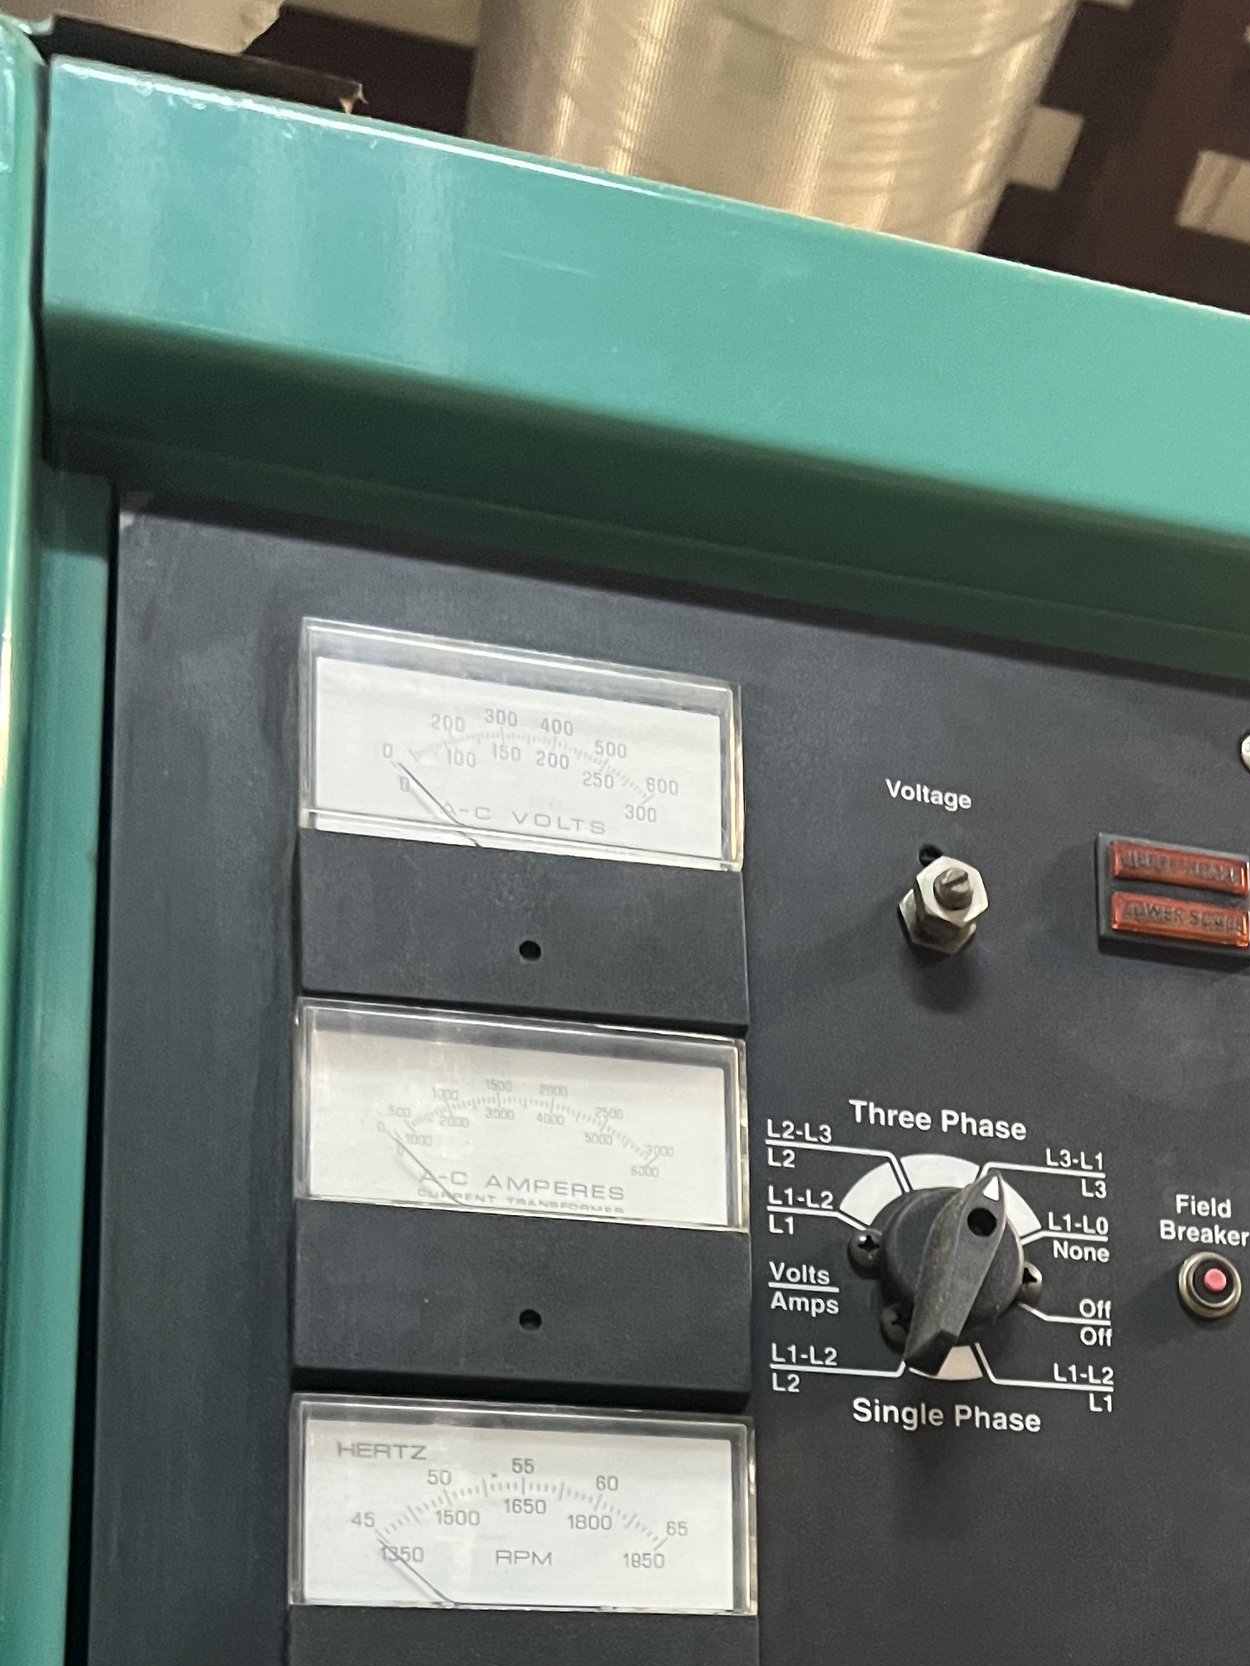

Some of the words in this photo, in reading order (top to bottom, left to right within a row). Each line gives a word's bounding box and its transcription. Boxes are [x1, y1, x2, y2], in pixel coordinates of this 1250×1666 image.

[382, 742, 394, 759] 0
[430, 713, 465, 734] 200
[484, 708, 518, 728] 300
[540, 716, 574, 737] 400
[594, 739, 627, 759] 500
[646, 778, 679, 797] 600
[446, 750, 476, 769] 100
[492, 744, 522, 763] 150
[535, 750, 570, 771] 200
[583, 771, 615, 791] 250
[624, 804, 657, 824] 300
[885, 778, 972, 812] Voltage
[512, 810, 606, 836] VOLTS
[432, 1088, 460, 1102] 1000
[486, 1079, 514, 1092] 1500
[767, 1119, 832, 1143] L2-L3
[849, 1099, 932, 1130] Three
[941, 1110, 1027, 1140] Phase
[767, 1148, 796, 1169] L2
[1046, 1148, 1104, 1170] L3-L1
[419, 1170, 468, 1186] A-C
[485, 1175, 624, 1202] AMPERES
[768, 1185, 834, 1209] L1-L2
[1081, 1178, 1107, 1199] L3
[1176, 1193, 1232, 1218] Field
[768, 1214, 795, 1235] L1
[1160, 1219, 1250, 1247] Breaker
[1053, 1241, 1110, 1263] None
[769, 1261, 831, 1286] Volts
[770, 1291, 840, 1317] Amps
[1079, 1298, 1112, 1320] Off
[1080, 1326, 1112, 1347] Off
[771, 1342, 837, 1366] L1-L2
[772, 1373, 800, 1392] L2
[1053, 1363, 1114, 1385] L1-L2
[852, 1397, 944, 1432] Single
[955, 1404, 1041, 1432] Phase
[1089, 1393, 1114, 1413] L1
[337, 1440, 427, 1461] HERTZ
[351, 1511, 375, 1528] 45
[427, 1469, 452, 1486] 50
[511, 1457, 535, 1474] 55
[595, 1475, 619, 1492] 60
[665, 1521, 688, 1537] 65
[381, 1546, 425, 1563] 1350
[435, 1509, 480, 1526] 1500
[504, 1498, 547, 1515] 1650
[567, 1514, 613, 1531] 1800
[495, 1549, 553, 1566] RPM
